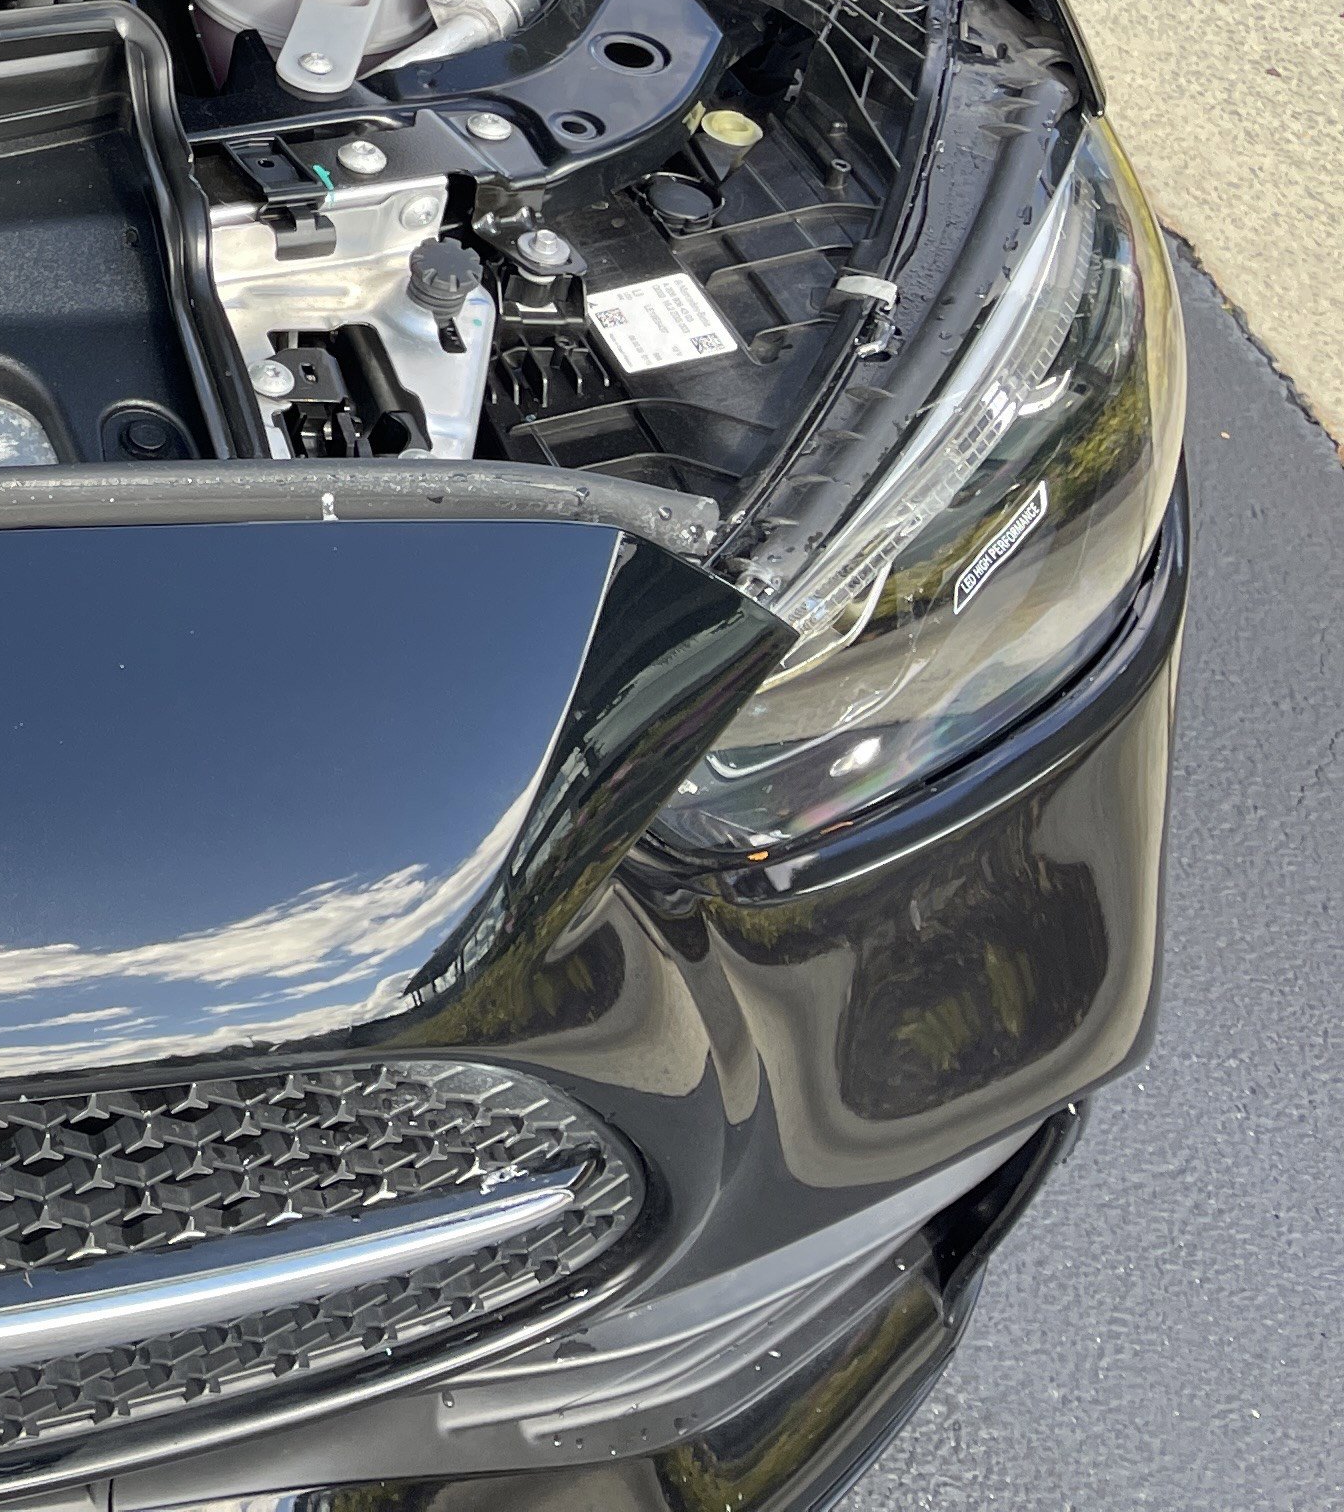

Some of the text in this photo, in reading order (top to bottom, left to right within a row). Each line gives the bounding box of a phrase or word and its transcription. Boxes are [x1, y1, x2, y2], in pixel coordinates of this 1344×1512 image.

[959, 501, 1041, 594] LED HIGH PERFORMANCE
